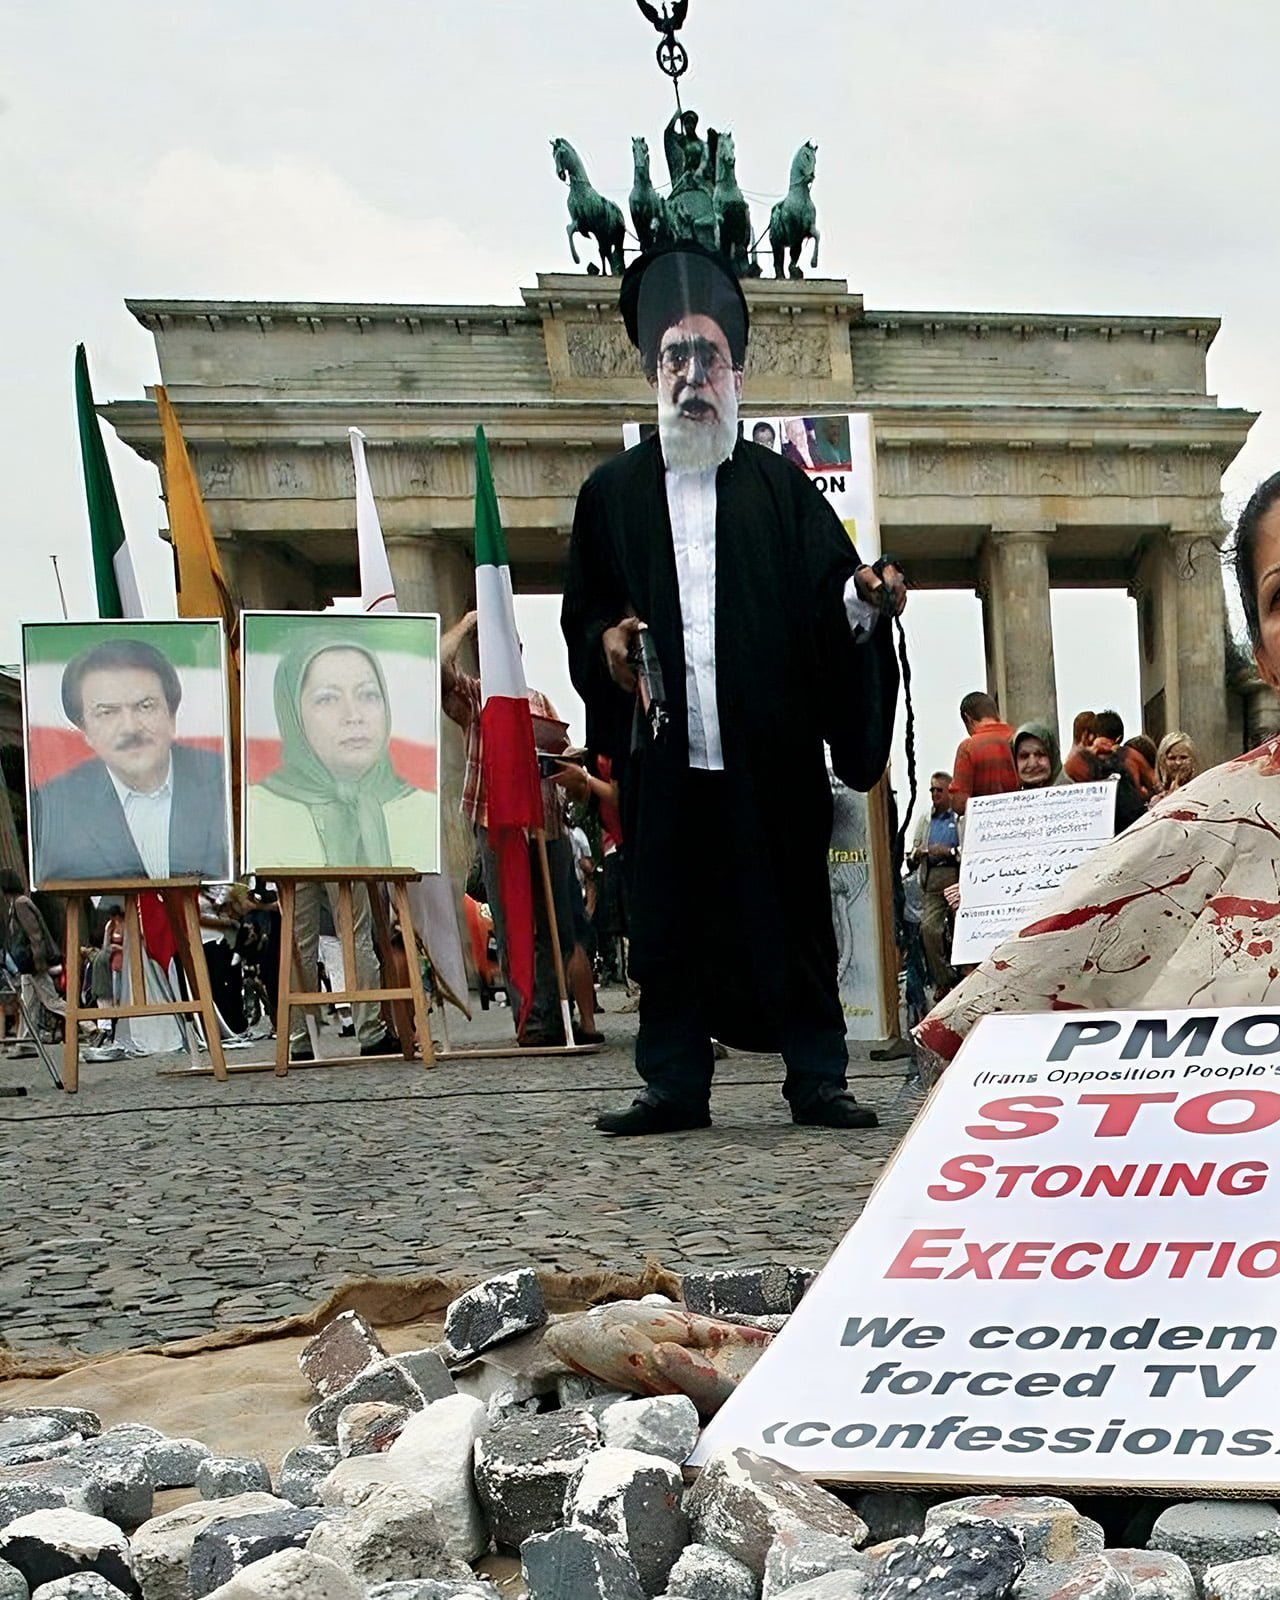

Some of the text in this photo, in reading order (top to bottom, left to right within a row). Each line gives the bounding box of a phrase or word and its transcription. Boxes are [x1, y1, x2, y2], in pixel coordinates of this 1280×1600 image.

[1047, 1066, 1176, 1084] Opposition
[927, 1153, 1268, 1201] STONING
[840, 1317, 945, 1349] We
[860, 1363, 1257, 1399] forced TV
